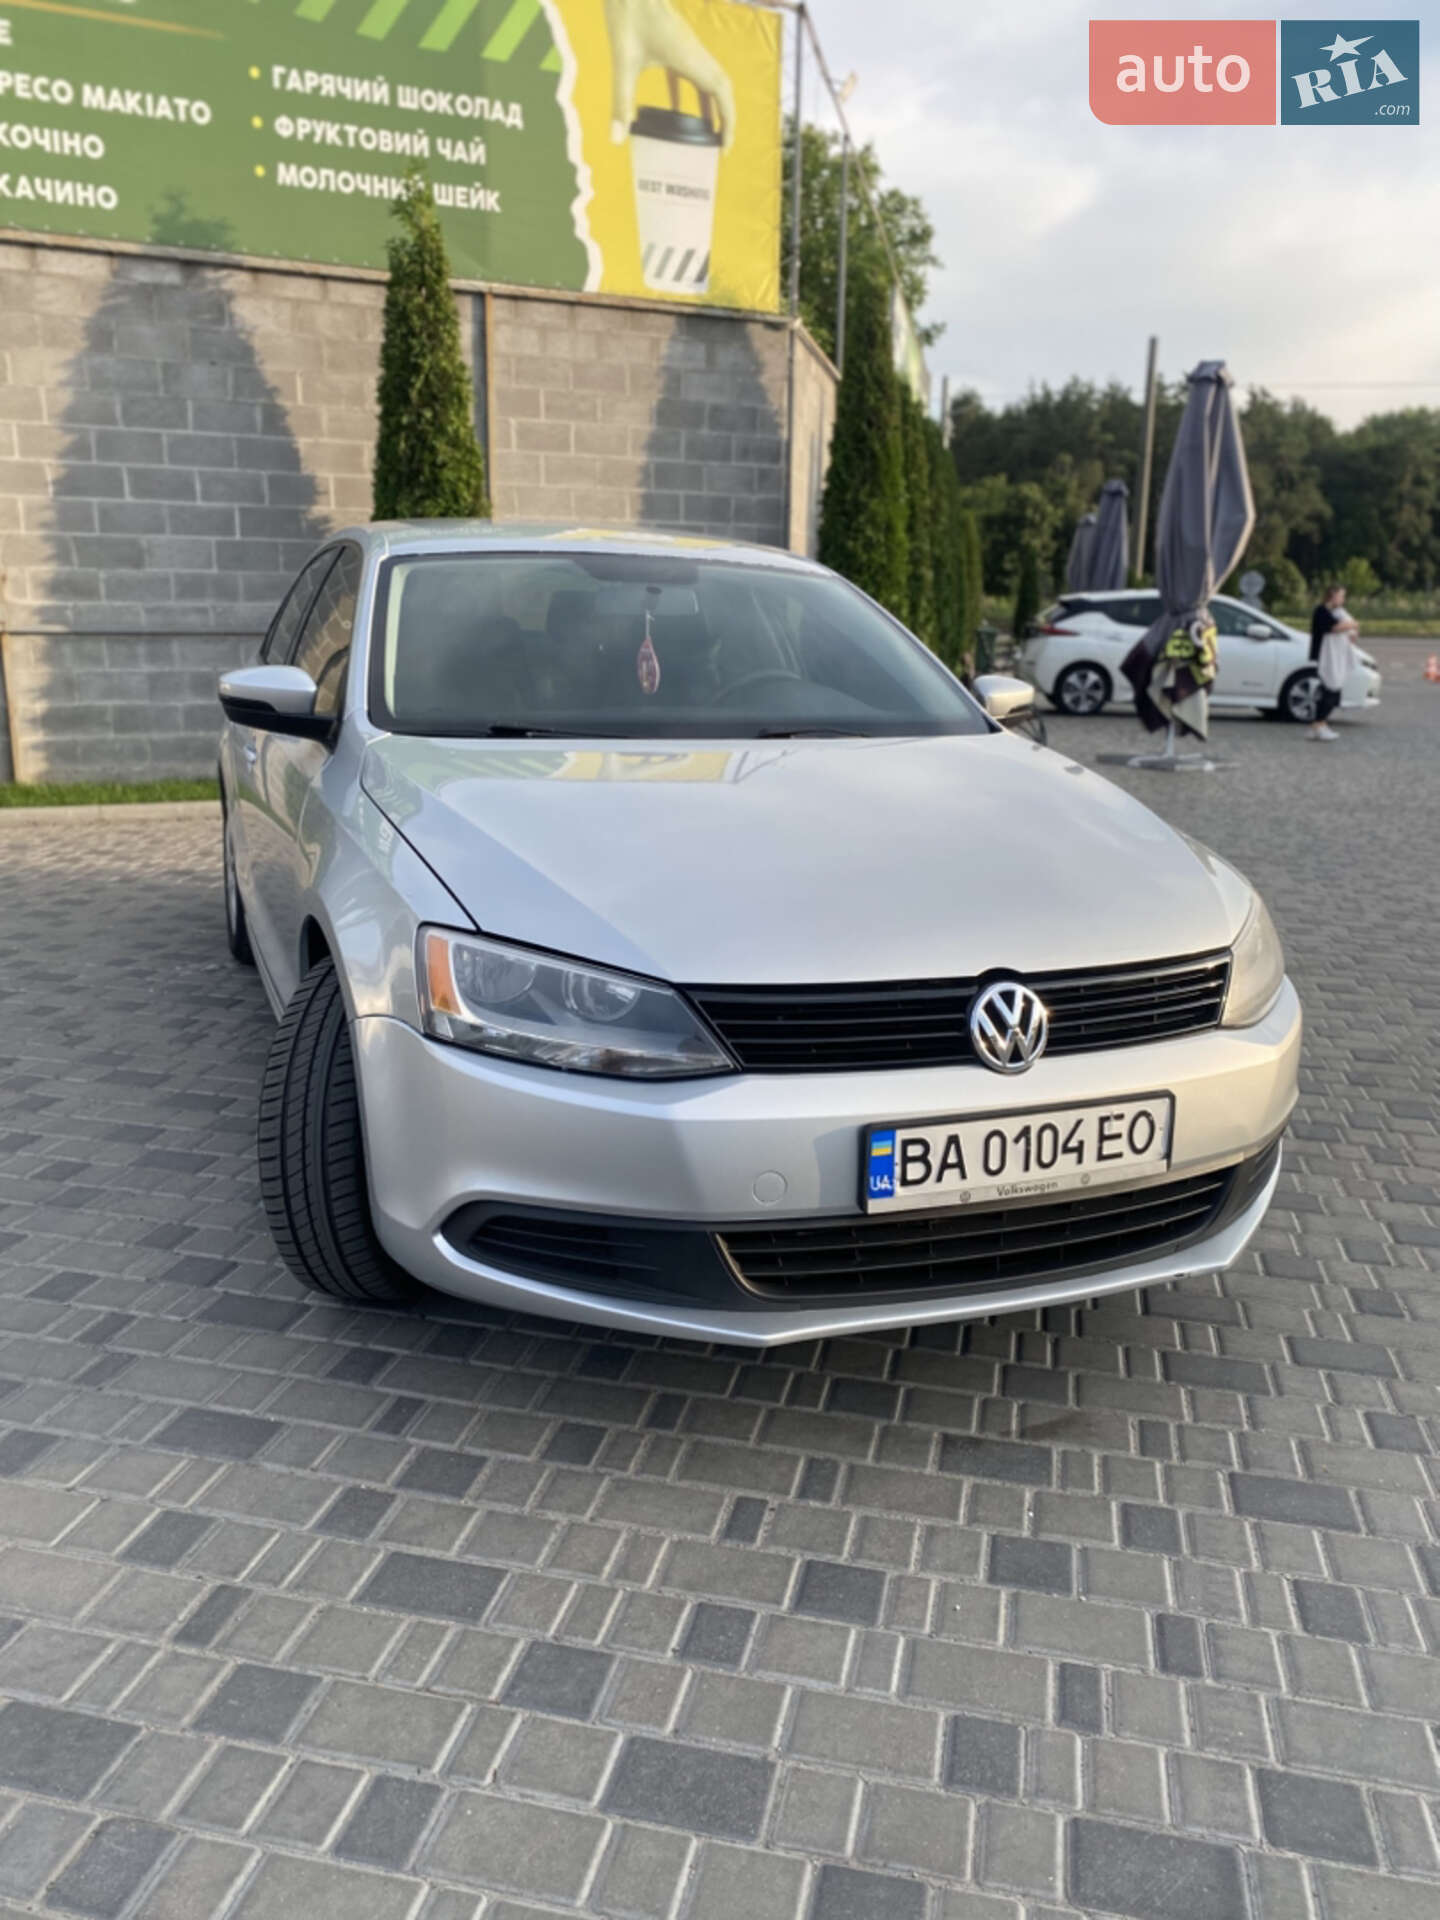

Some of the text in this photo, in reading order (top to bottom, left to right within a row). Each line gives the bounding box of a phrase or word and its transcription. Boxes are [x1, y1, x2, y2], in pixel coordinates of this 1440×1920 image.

[82, 83, 212, 126] МАКІАТО
[271, 65, 524, 130] ГАРЯЧИЙ ШОКОЛАД
[274, 114, 487, 165] ФРУКТОВИЙ ЧАЙ
[433, 182, 501, 213] ШЕЙК
[899, 1109, 1156, 1187] BA 0104 EO
[869, 1174, 893, 1192] UA
[996, 1181, 1059, 1197] Volkswagen
